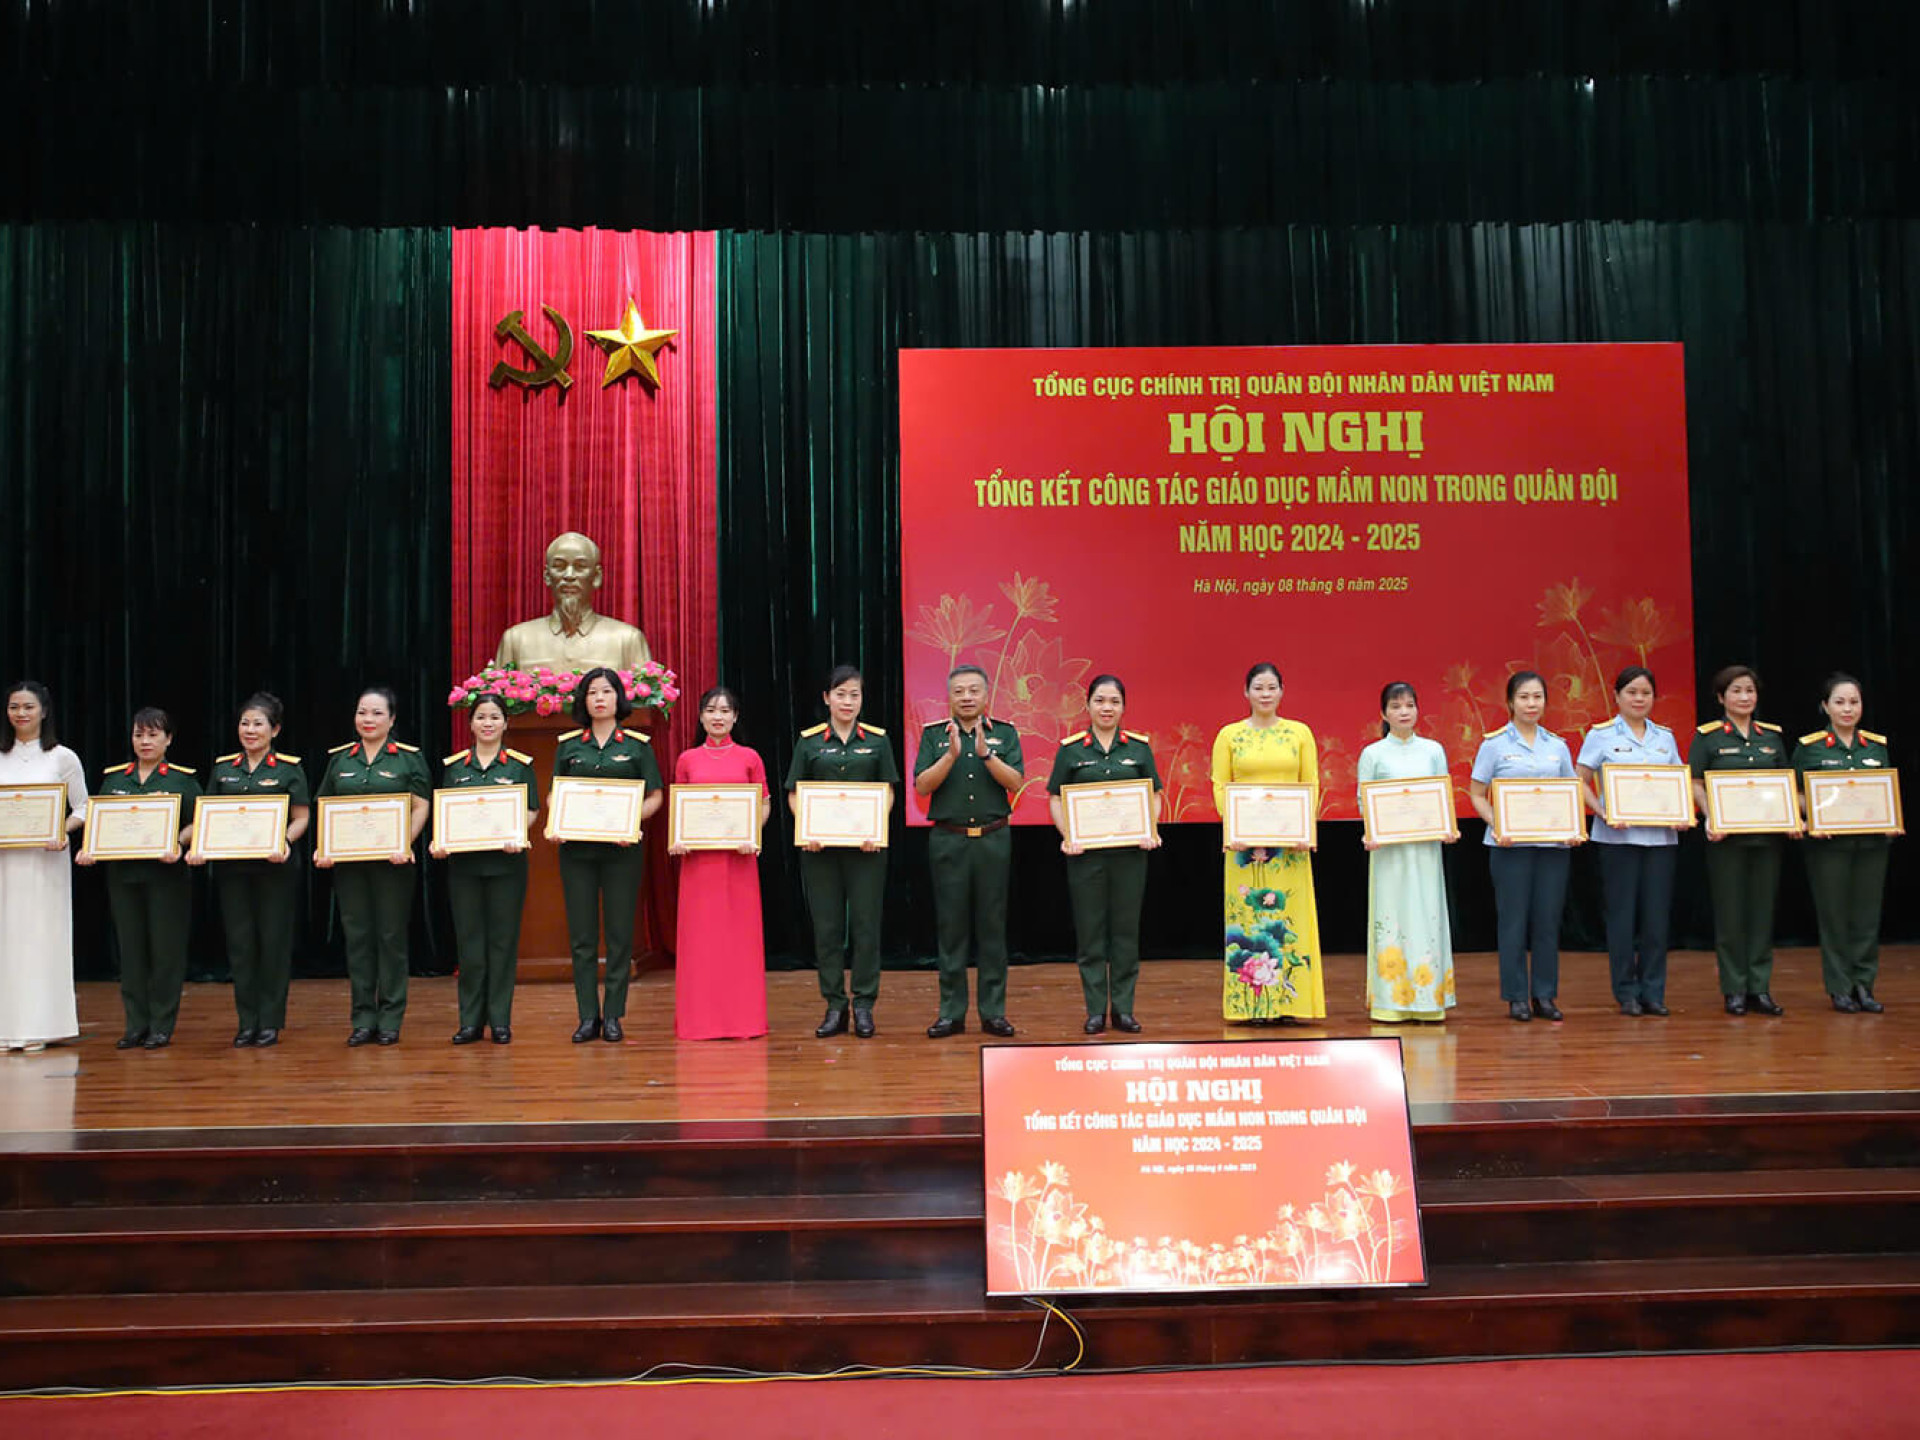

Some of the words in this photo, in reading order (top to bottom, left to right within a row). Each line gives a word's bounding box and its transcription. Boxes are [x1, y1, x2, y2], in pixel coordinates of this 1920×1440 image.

[1033, 371, 1086, 397] TỔNG
[1093, 376, 1134, 400] CỤC
[1141, 372, 1203, 396] CHÍNH
[1209, 376, 1240, 400] TRỊ
[1247, 372, 1302, 397] QUÂN
[1308, 371, 1342, 398] ĐỘI
[1349, 371, 1405, 394] NHÂN
[1412, 370, 1453, 393] DÂN
[1459, 369, 1501, 397] VIỆT
[1508, 373, 1554, 393] NAM
[1168, 404, 1265, 462] HỘI
[1282, 411, 1424, 459] NGHỊ
[975, 468, 1033, 507] TỔNG
[1041, 470, 1082, 507] KẾT
[1089, 472, 1150, 506] CÔNG
[1156, 472, 1198, 505] TÁC
[1206, 471, 1258, 505] GIÁO
[1265, 476, 1310, 510] DỤC
[1318, 466, 1373, 504] MẦM
[1380, 474, 1427, 503] NON
[1434, 474, 1506, 503] TRONG
[1514, 468, 1573, 505] QUÂN
[1580, 468, 1618, 507] ĐỘI
[1180, 519, 1231, 553] NĂM
[1239, 524, 1284, 558] HỌC
[1291, 523, 1345, 552] 2024
[1367, 523, 1421, 551] 2025
[1193, 578, 1211, 593] Hà
[1214, 578, 1240, 596] Nội,
[1243, 578, 1275, 596] ngày
[1278, 578, 1294, 593] 08
[1296, 577, 1333, 595] tháng
[1336, 577, 1345, 592] 8
[1348, 577, 1375, 591] năm
[1378, 576, 1409, 591] 2025
[1126, 1077, 1178, 1106] HỘI
[1186, 1078, 1263, 1104] NGHỊ
[1085, 1111, 1118, 1130] CÔNG
[1121, 1111, 1144, 1129] TÁC
[1178, 1113, 1202, 1130] DỤC
[1268, 1110, 1308, 1126] TRONG
